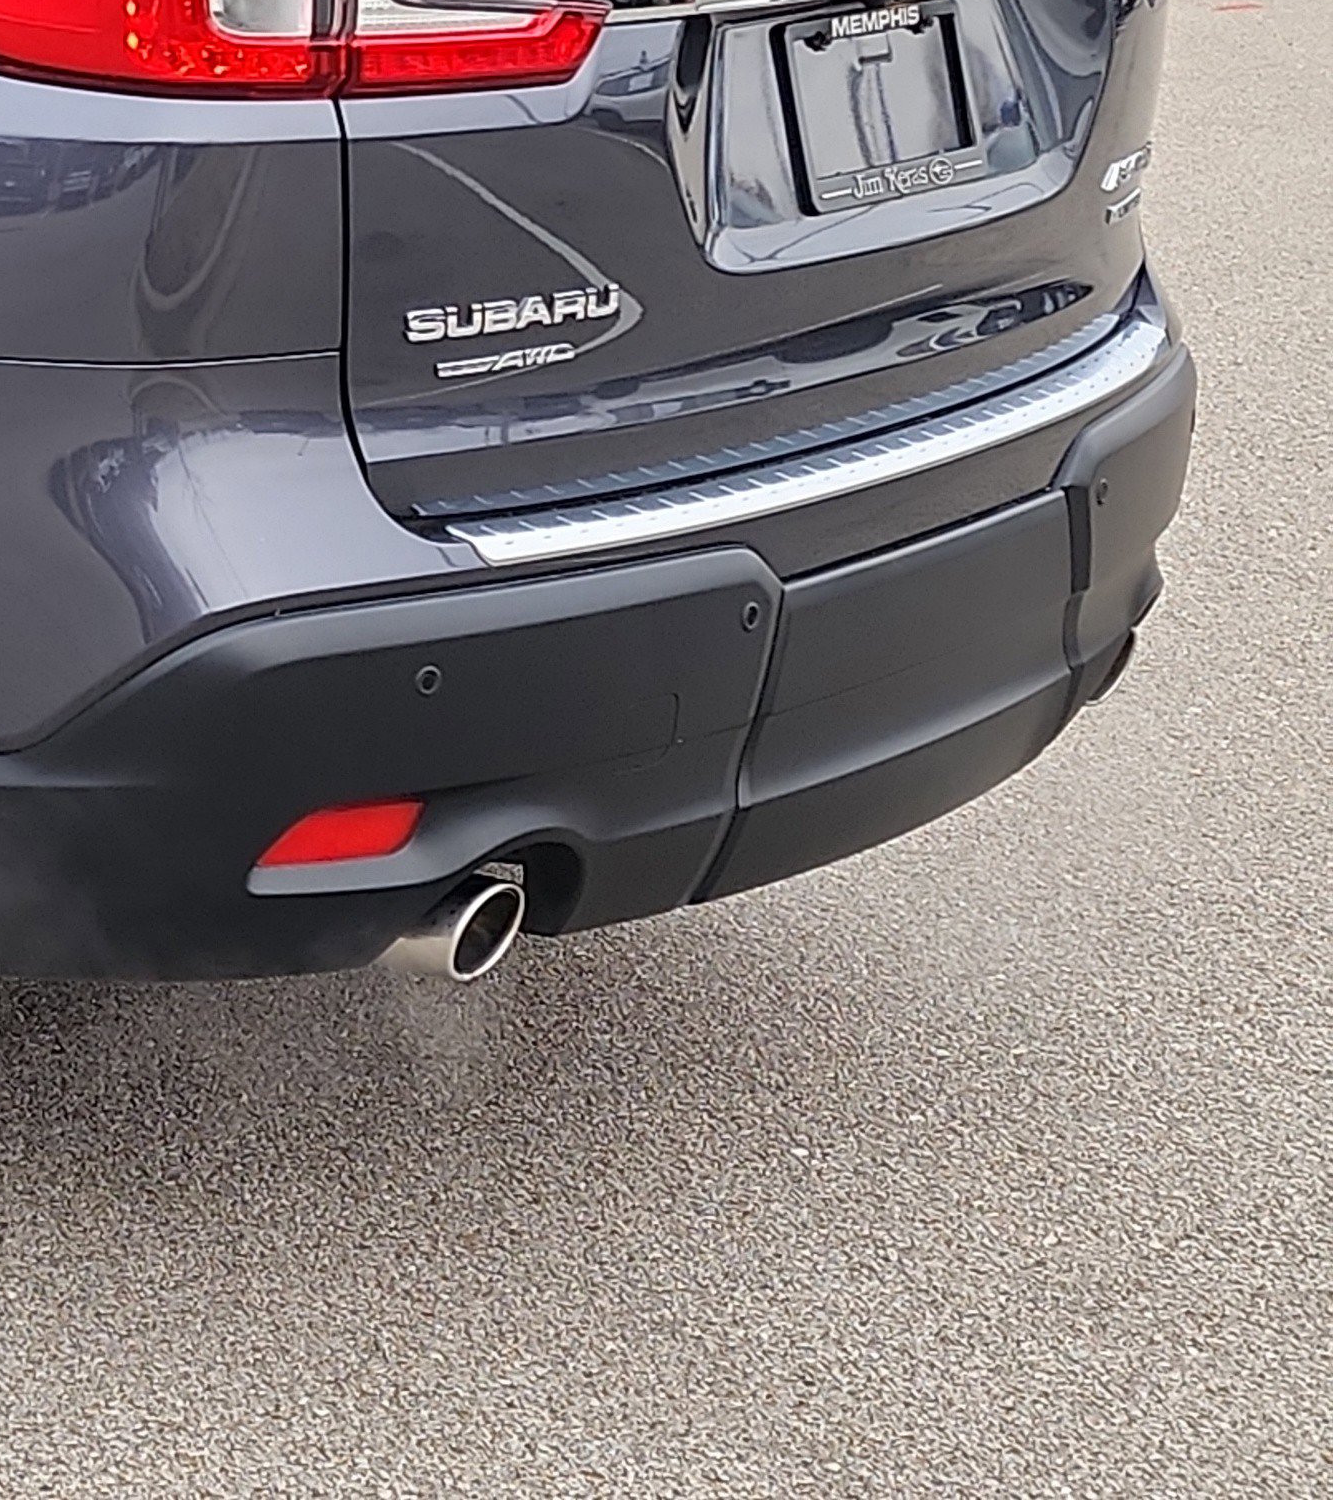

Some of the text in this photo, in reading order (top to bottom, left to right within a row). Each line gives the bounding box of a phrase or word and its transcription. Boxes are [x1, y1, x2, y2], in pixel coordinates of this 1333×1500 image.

[832, 5, 921, 37] MEMPHIS
[405, 283, 620, 343] SUBARU
[491, 343, 576, 372] AWD
